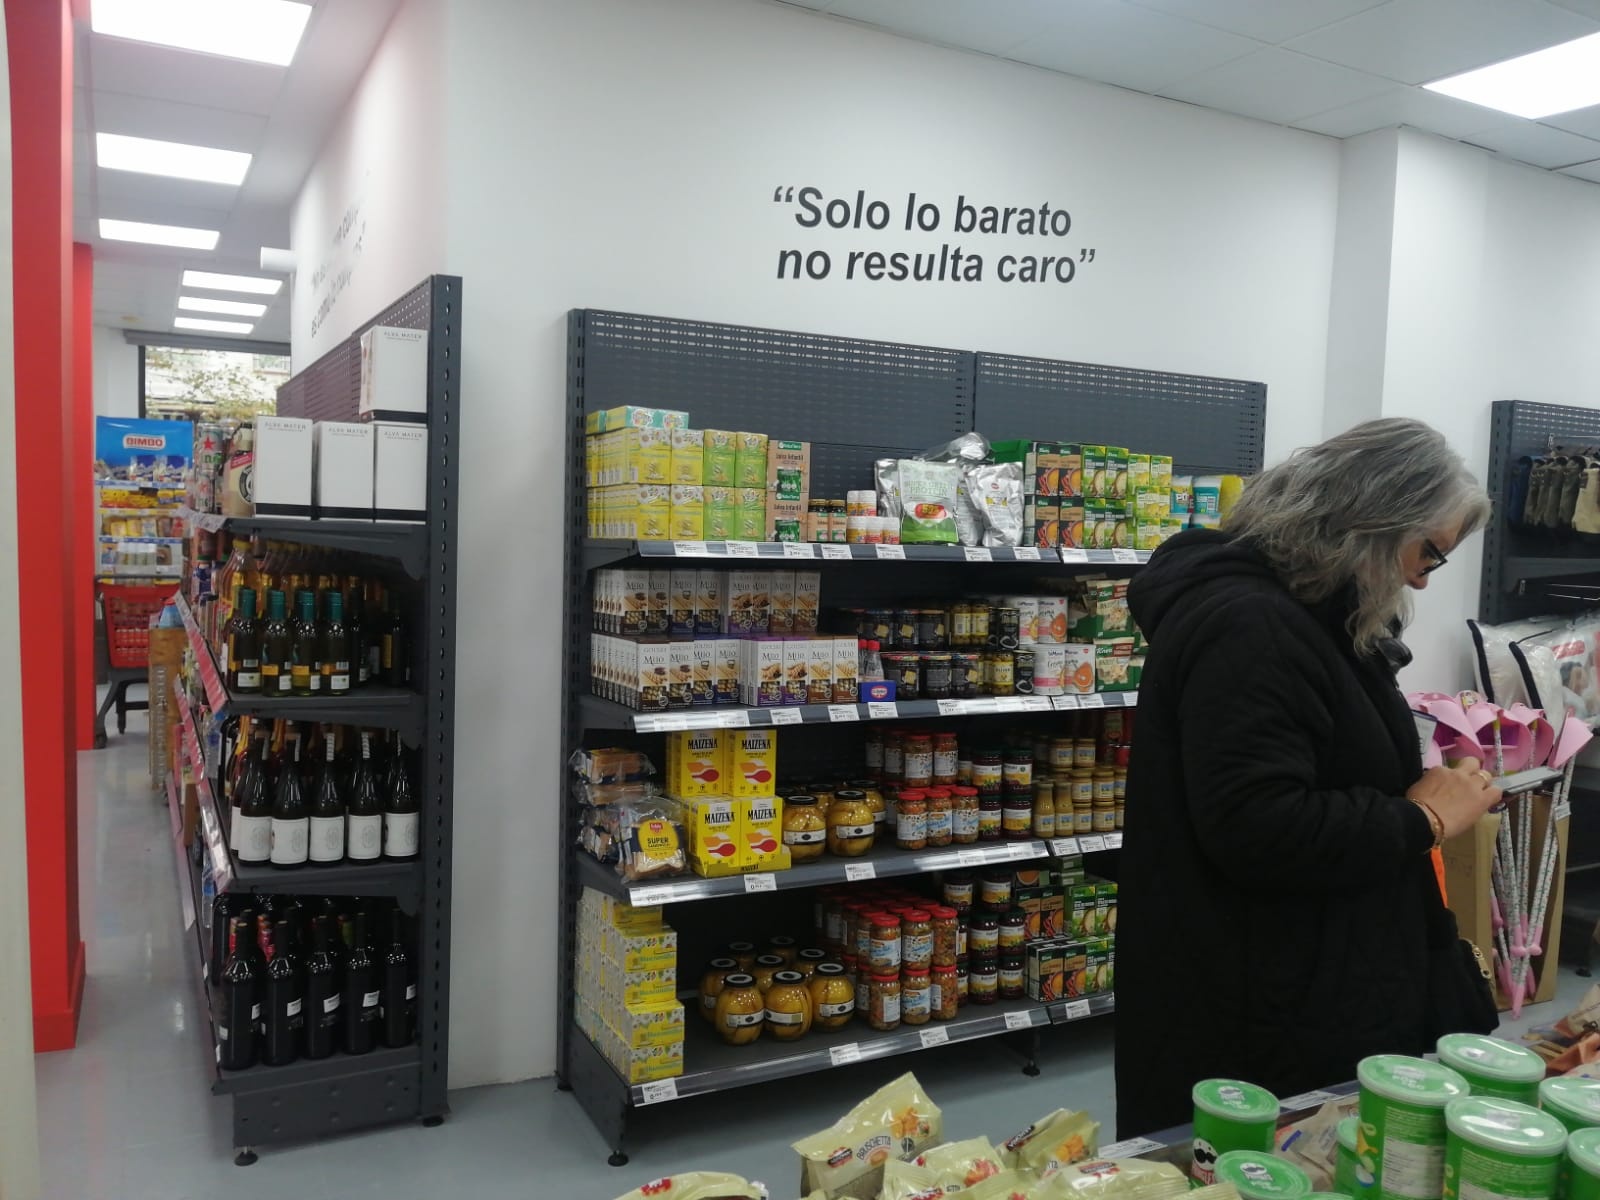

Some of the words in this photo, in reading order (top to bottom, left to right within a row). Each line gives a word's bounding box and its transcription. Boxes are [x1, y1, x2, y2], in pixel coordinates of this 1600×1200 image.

[773, 186, 890, 230] “Solo
[905, 192, 940, 231] lo
[954, 195, 1071, 237] barato
[777, 249, 831, 280] no
[846, 243, 983, 282] resulta
[997, 248, 1096, 283] caro”
[126, 436, 164, 448] BIMBO
[688, 738, 718, 750] MAIZENA
[742, 738, 771, 750] MAIZENA
[705, 811, 736, 824] MAIZENA
[747, 808, 777, 821] MAIZENA
